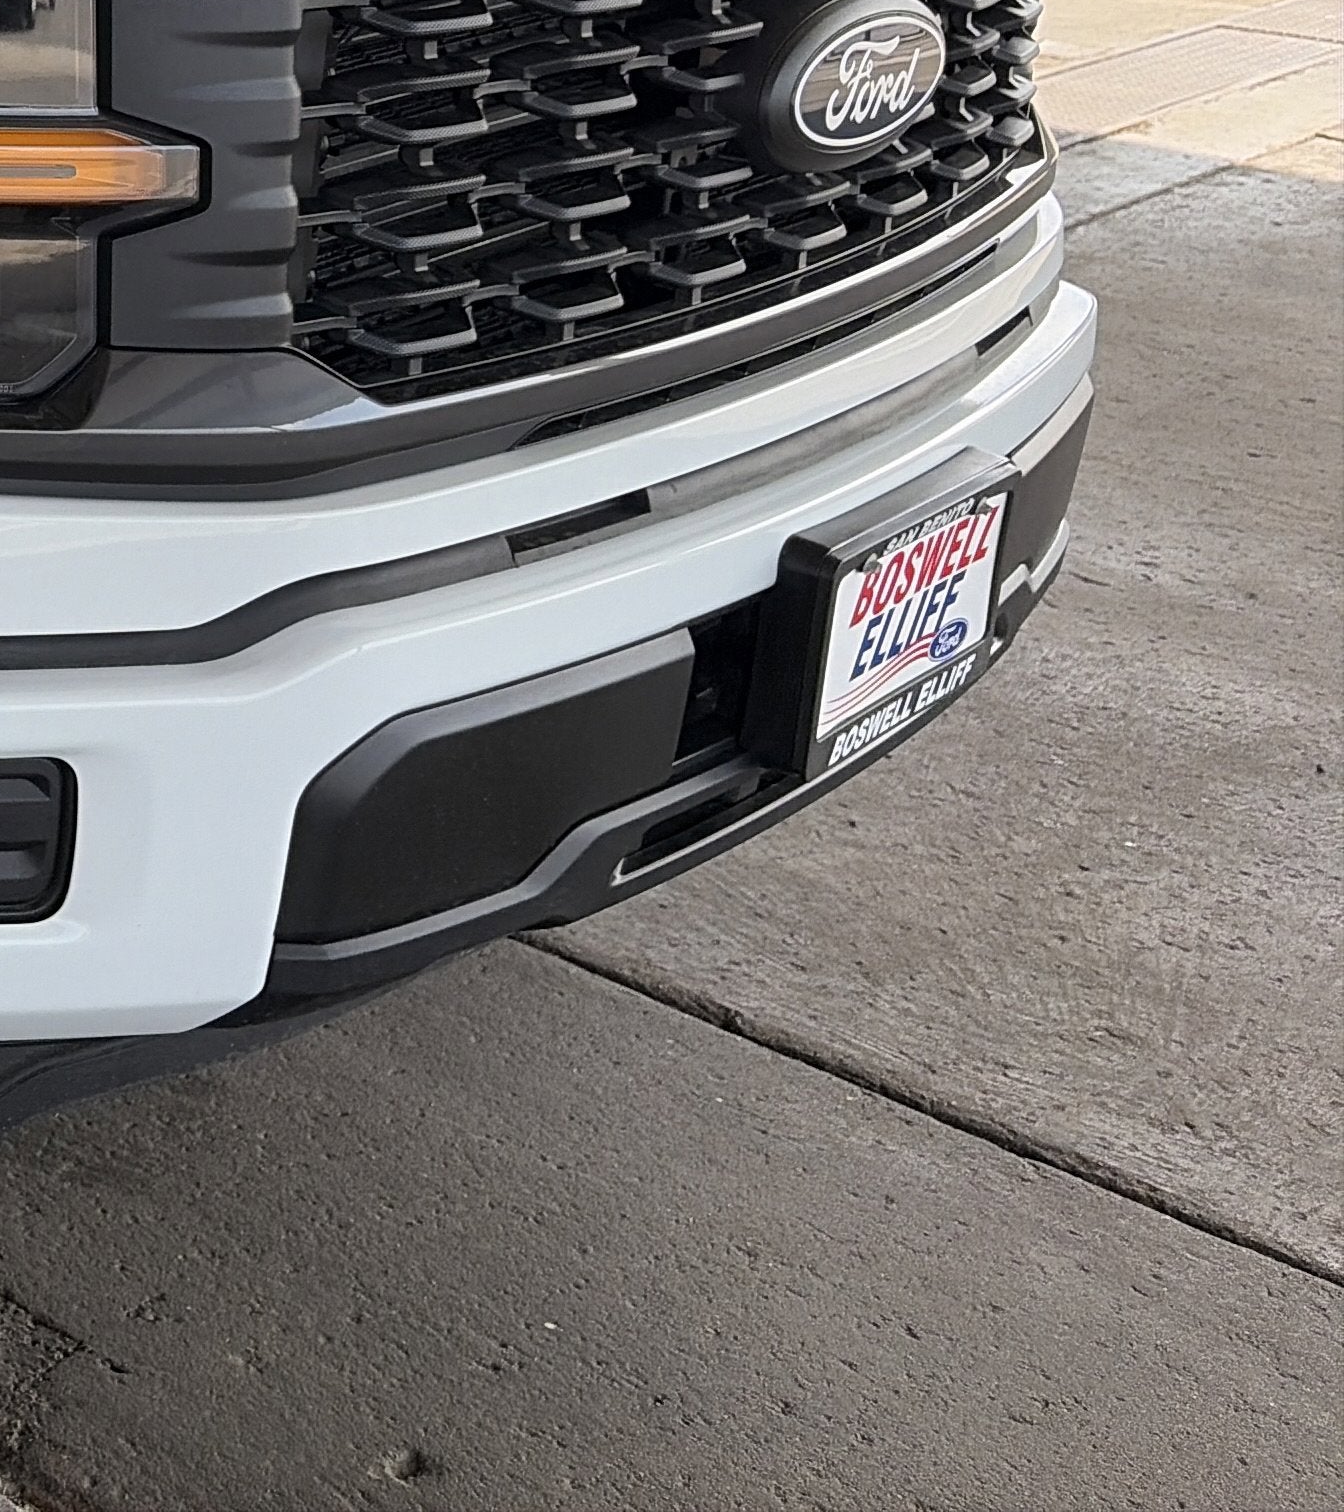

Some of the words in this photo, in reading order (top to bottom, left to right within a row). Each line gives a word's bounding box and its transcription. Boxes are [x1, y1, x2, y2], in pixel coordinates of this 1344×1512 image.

[825, 35, 921, 132] Ford
[849, 504, 1000, 628] BOSWELL
[883, 526, 920, 555] SAN
[919, 498, 975, 538] BENITO
[849, 570, 968, 682] ELLIFF
[932, 623, 964, 656] Ford
[828, 690, 913, 767] BOSWELL
[914, 652, 977, 714] ELLIFF
